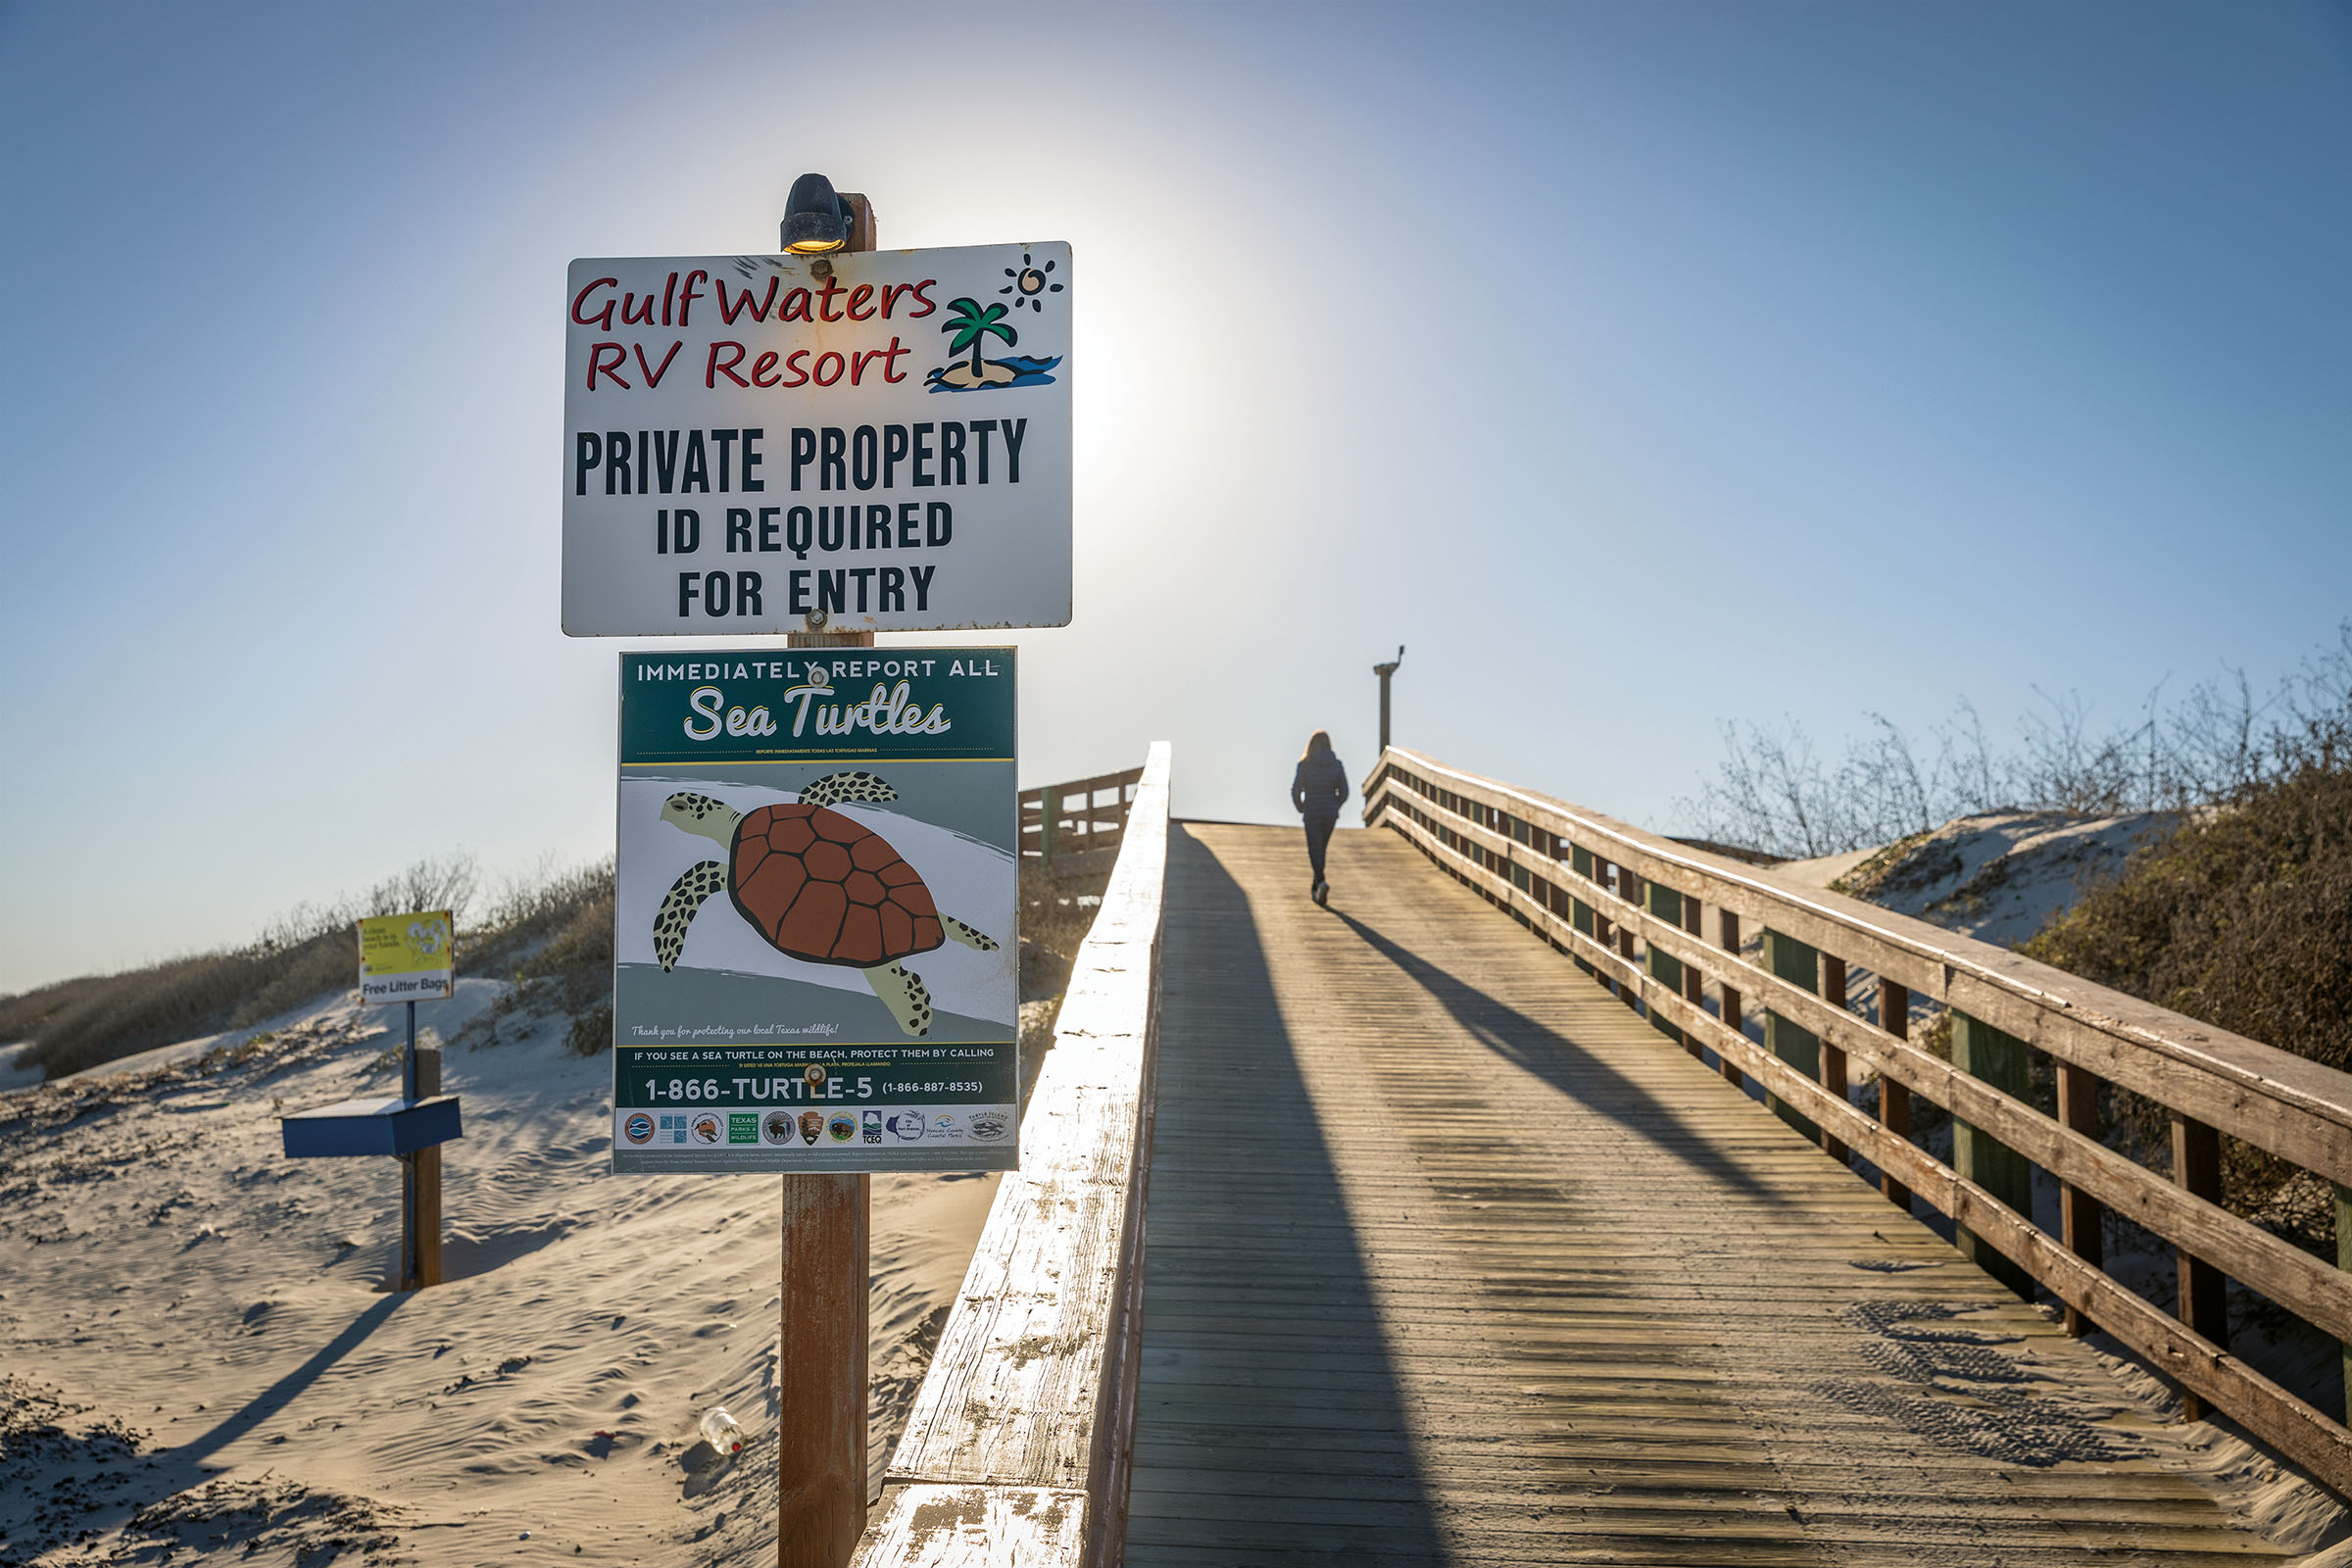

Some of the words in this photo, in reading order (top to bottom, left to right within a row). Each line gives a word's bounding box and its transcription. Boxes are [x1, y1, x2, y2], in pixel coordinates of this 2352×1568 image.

[586, 340, 683, 391] RV
[706, 336, 911, 389] Resort
[575, 428, 764, 496] PRIVATE
[790, 418, 1028, 492] PROPERTY
[657, 509, 701, 555] ID
[725, 501, 954, 561] REQUIRED
[678, 571, 762, 617] FOR
[788, 565, 936, 616] ENTRY
[833, 660, 936, 678] REPORT
[949, 660, 999, 676] ALL
[683, 686, 777, 742] Sea
[784, 679, 952, 738] Turtles
[363, 983, 387, 995] Free
[389, 980, 419, 993] Litter
[420, 978, 448, 992] Bags
[632, 1025, 660, 1036] Thank
[661, 1028, 676, 1040] you
[677, 1025, 691, 1038] for
[692, 1025, 735, 1039] protecting
[754, 1024, 774, 1035] local
[776, 1024, 801, 1035] Texas
[803, 1023, 839, 1036] wildlife!
[634, 1052, 643, 1060] IF
[646, 1052, 666, 1060] YOU
[725, 1051, 764, 1059] TURTLE
[809, 1050, 847, 1059] BEACH,
[851, 1050, 898, 1058] PROTECT
[901, 1049, 930, 1057] THEM
[933, 1049, 946, 1057] BY
[950, 1049, 994, 1057] CALLING
[645, 1077, 873, 1101] 1-866-TURTLE-5
[882, 1082, 983, 1095] (1-866-887-8535)
